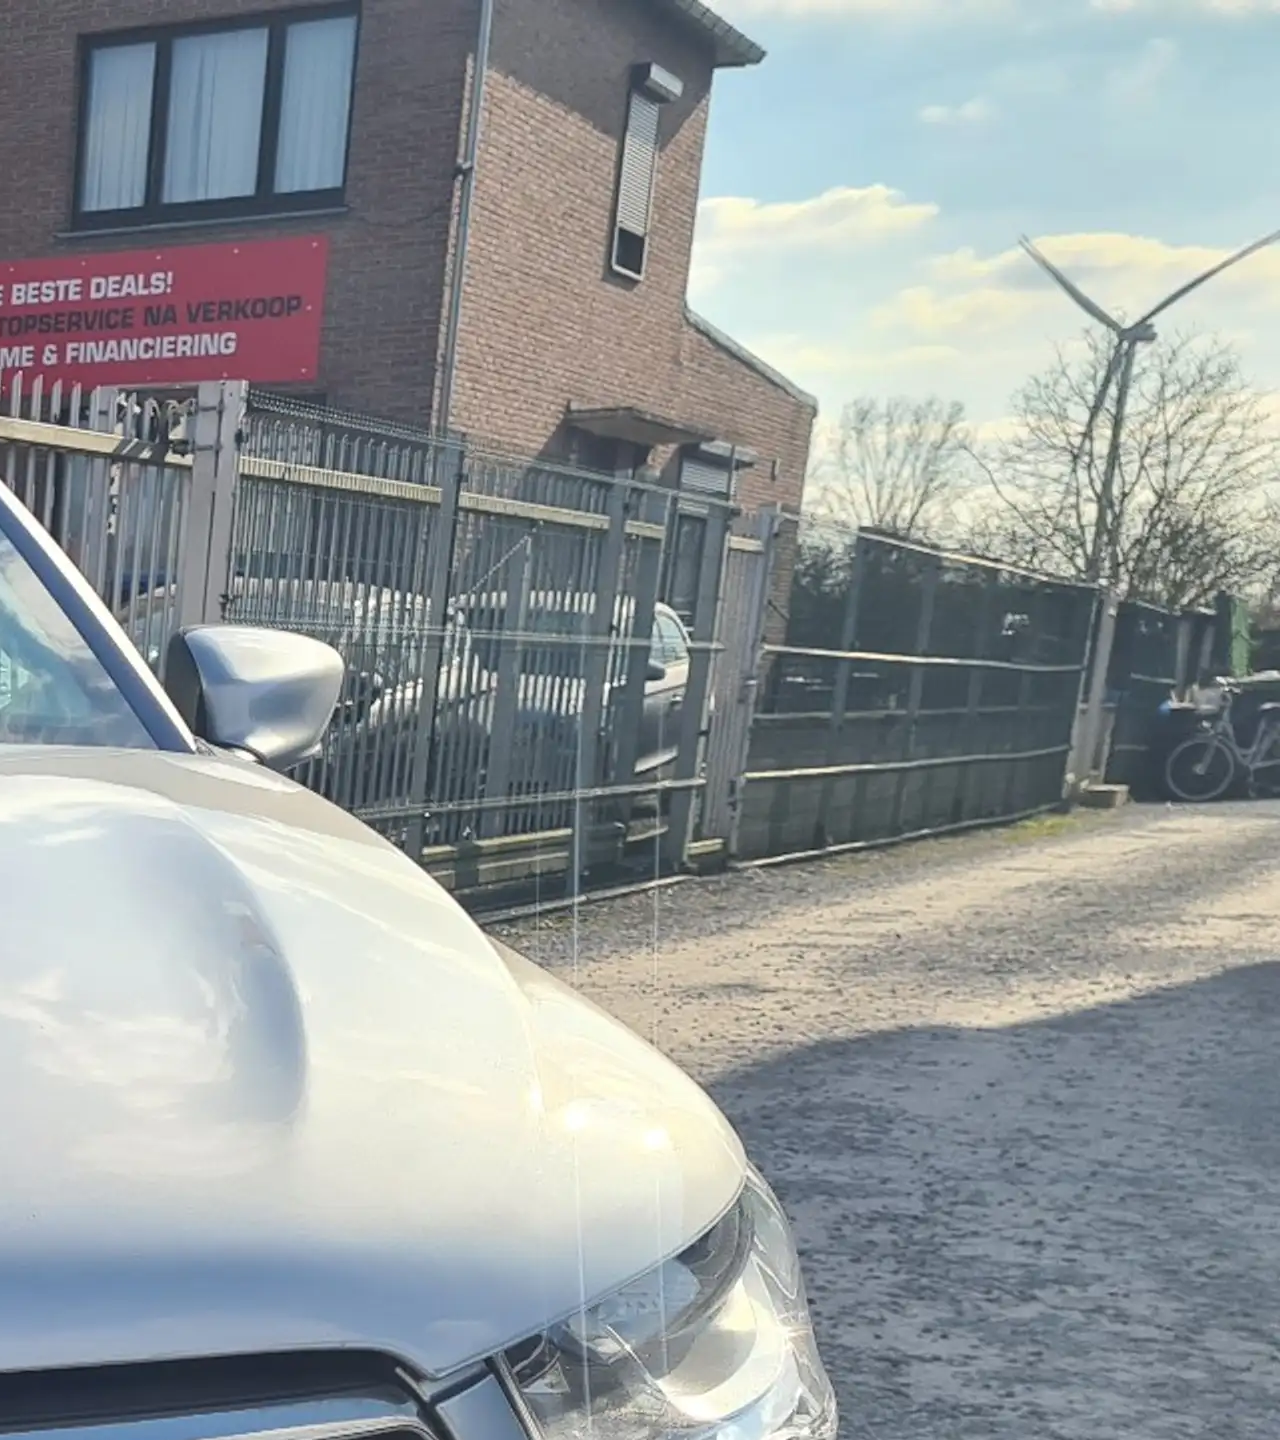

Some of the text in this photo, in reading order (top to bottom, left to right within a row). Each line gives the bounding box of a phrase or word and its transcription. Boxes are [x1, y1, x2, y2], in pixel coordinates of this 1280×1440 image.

[11, 279, 83, 305] BESTE
[90, 271, 174, 299] DEALS!
[143, 305, 178, 327] NA
[186, 296, 302, 324] VERKOOP
[42, 344, 59, 366] &
[65, 331, 238, 364] FINANCIERING
